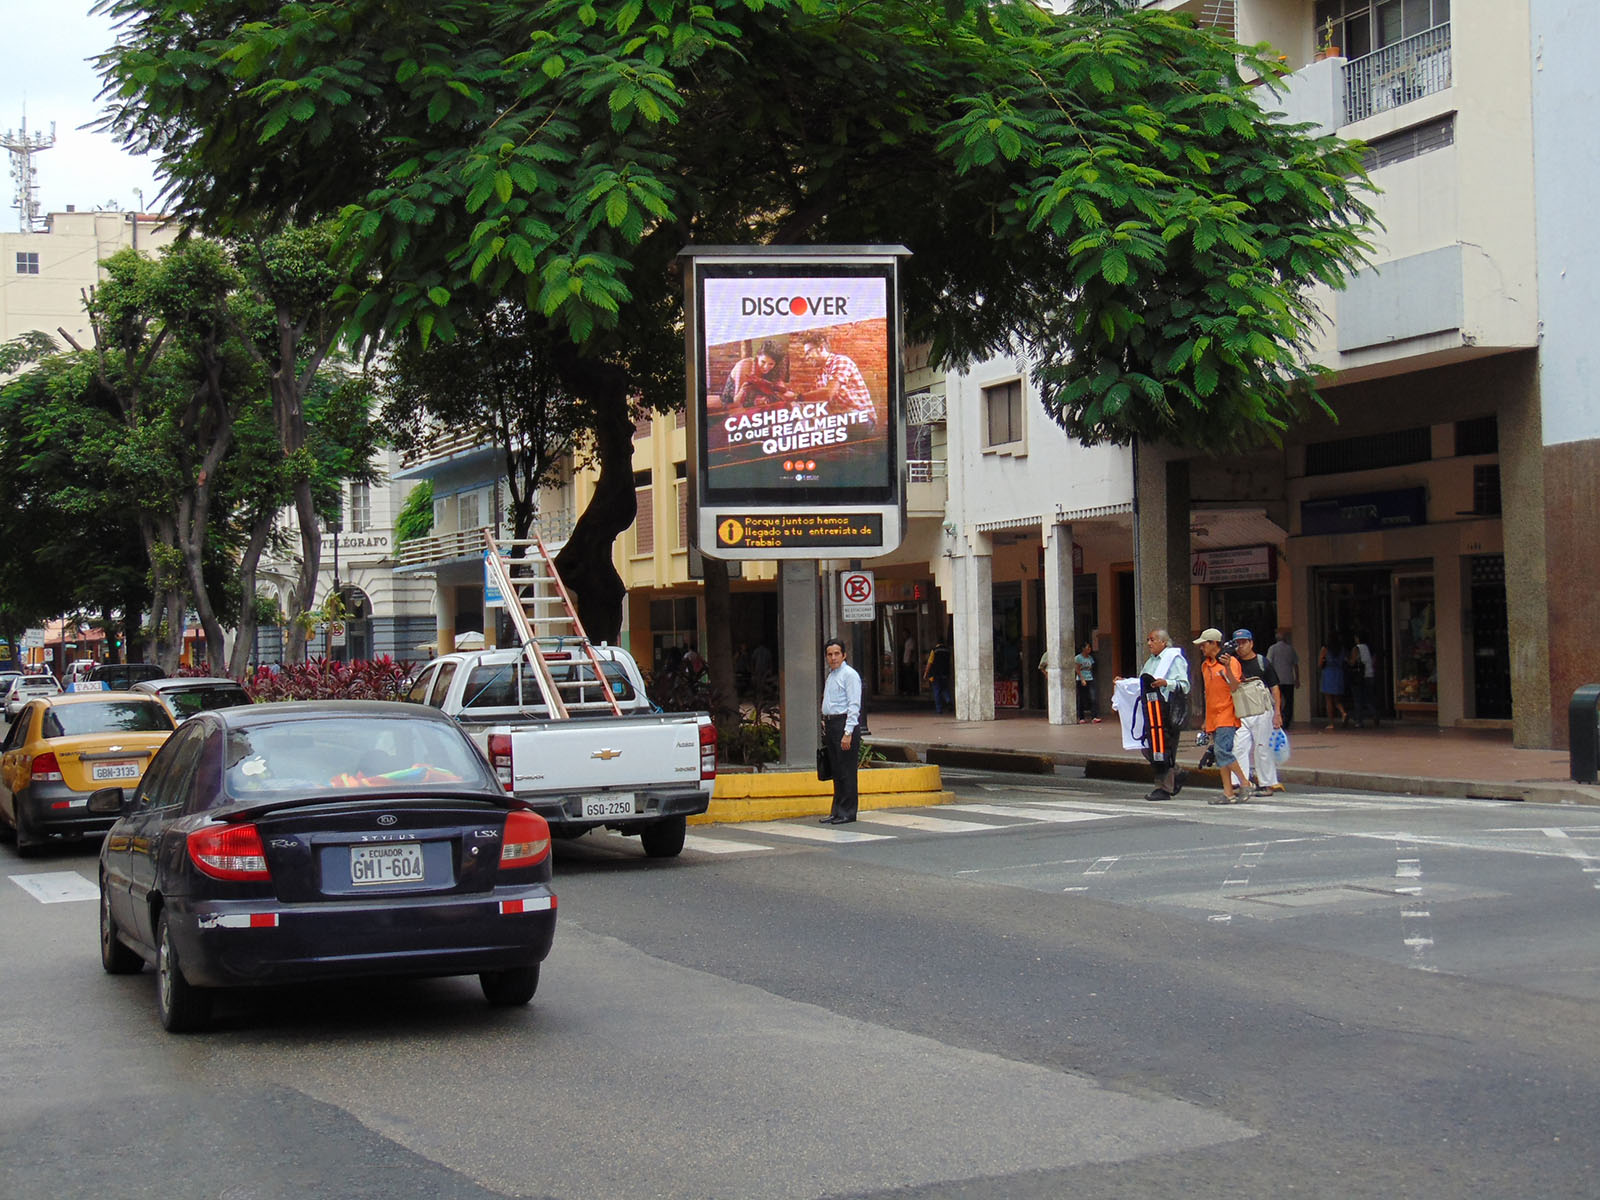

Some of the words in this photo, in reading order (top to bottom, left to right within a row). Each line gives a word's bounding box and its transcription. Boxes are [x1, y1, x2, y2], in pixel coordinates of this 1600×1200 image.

[741, 296, 848, 316] DISCOVER
[725, 401, 829, 432] CASHBACK
[728, 433, 743, 443] LO
[746, 428, 769, 439] QUE
[772, 411, 869, 438] REALMENTE
[762, 427, 848, 454] QUIERES
[745, 517, 780, 527] Porque
[782, 516, 814, 527] juntos
[817, 516, 849, 525] hemos
[745, 527, 781, 538] llegado
[791, 528, 803, 536] tu
[808, 527, 858, 536] entrevista
[859, 525, 872, 535] de
[380, 815, 394, 824] KIA
[474, 829, 499, 838] LSX
[269, 839, 298, 848] Rio
[369, 849, 403, 858] ECUADOR
[353, 857, 422, 880] GMI-604
